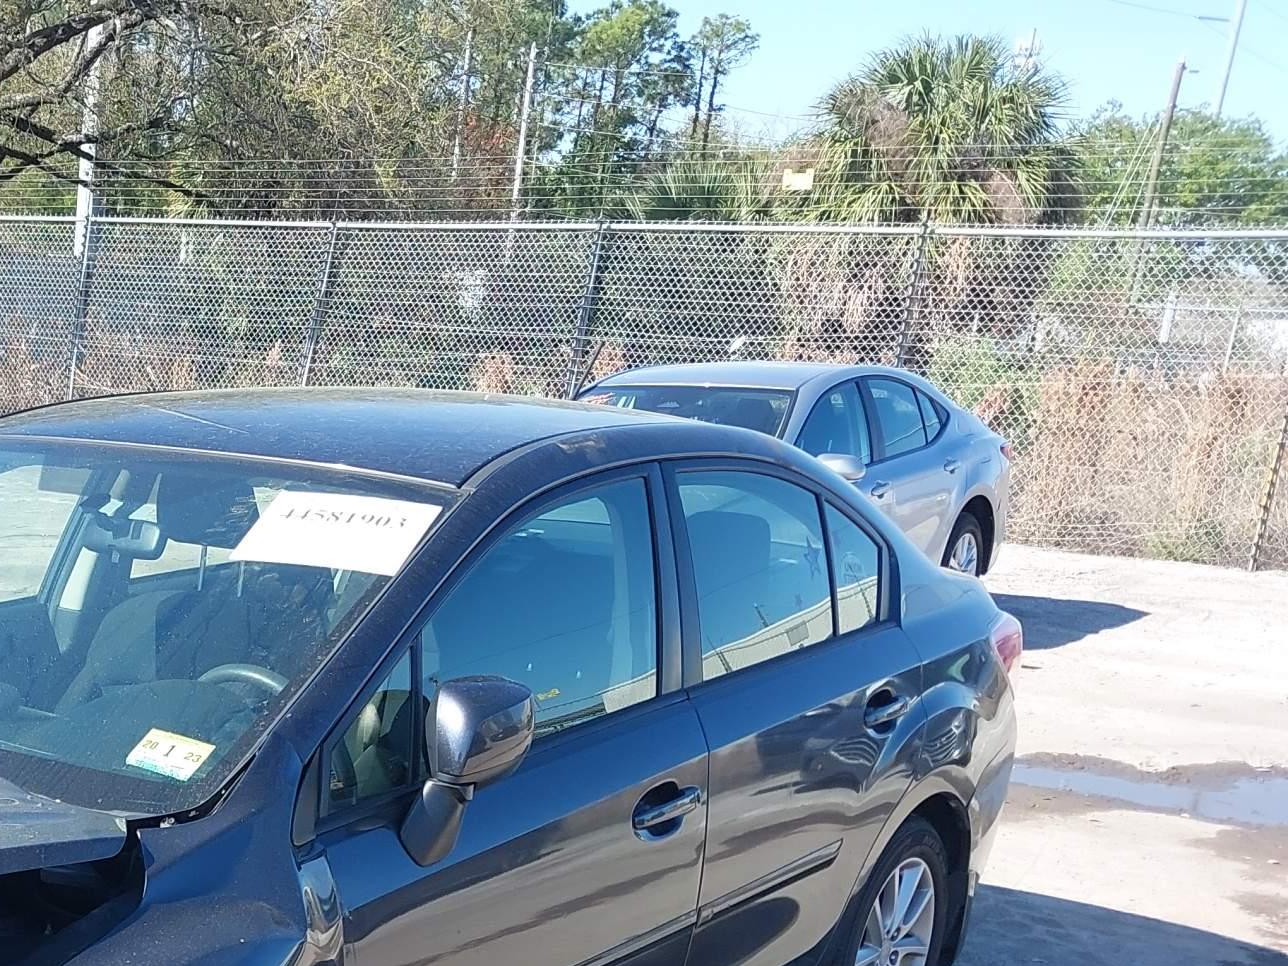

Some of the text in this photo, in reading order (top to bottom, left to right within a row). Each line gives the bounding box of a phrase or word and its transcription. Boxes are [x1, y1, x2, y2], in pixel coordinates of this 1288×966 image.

[280, 508, 408, 528] 44581903
[142, 740, 160, 750] 20
[163, 744, 177, 758] 1
[183, 752, 202, 763] 23
